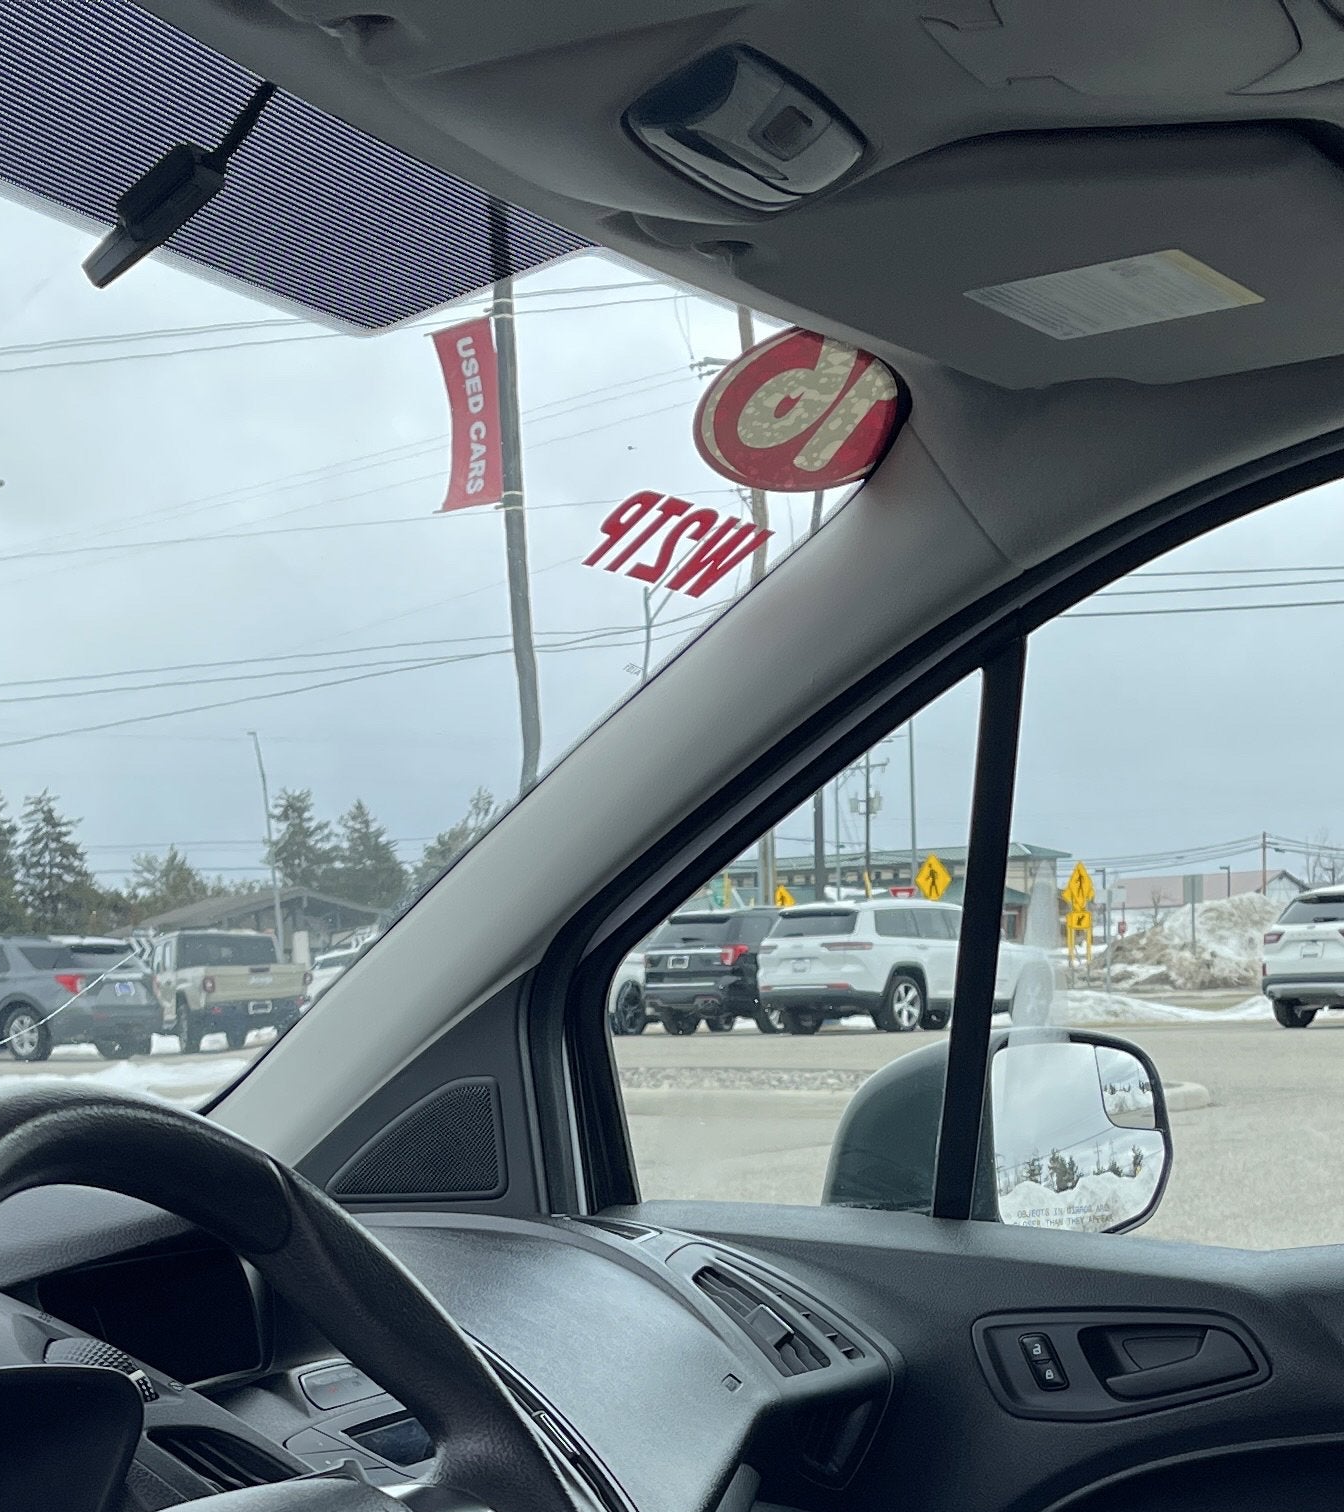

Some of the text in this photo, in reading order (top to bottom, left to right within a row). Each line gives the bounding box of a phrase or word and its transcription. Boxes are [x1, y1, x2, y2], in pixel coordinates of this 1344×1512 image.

[456, 336, 487, 495] USED CARS
[1017, 1208, 1050, 1219] OBJECTS
[1054, 1207, 1066, 1217] IN
[1046, 1218, 1063, 1227] THAN
[1068, 1216, 1084, 1225] THEY
